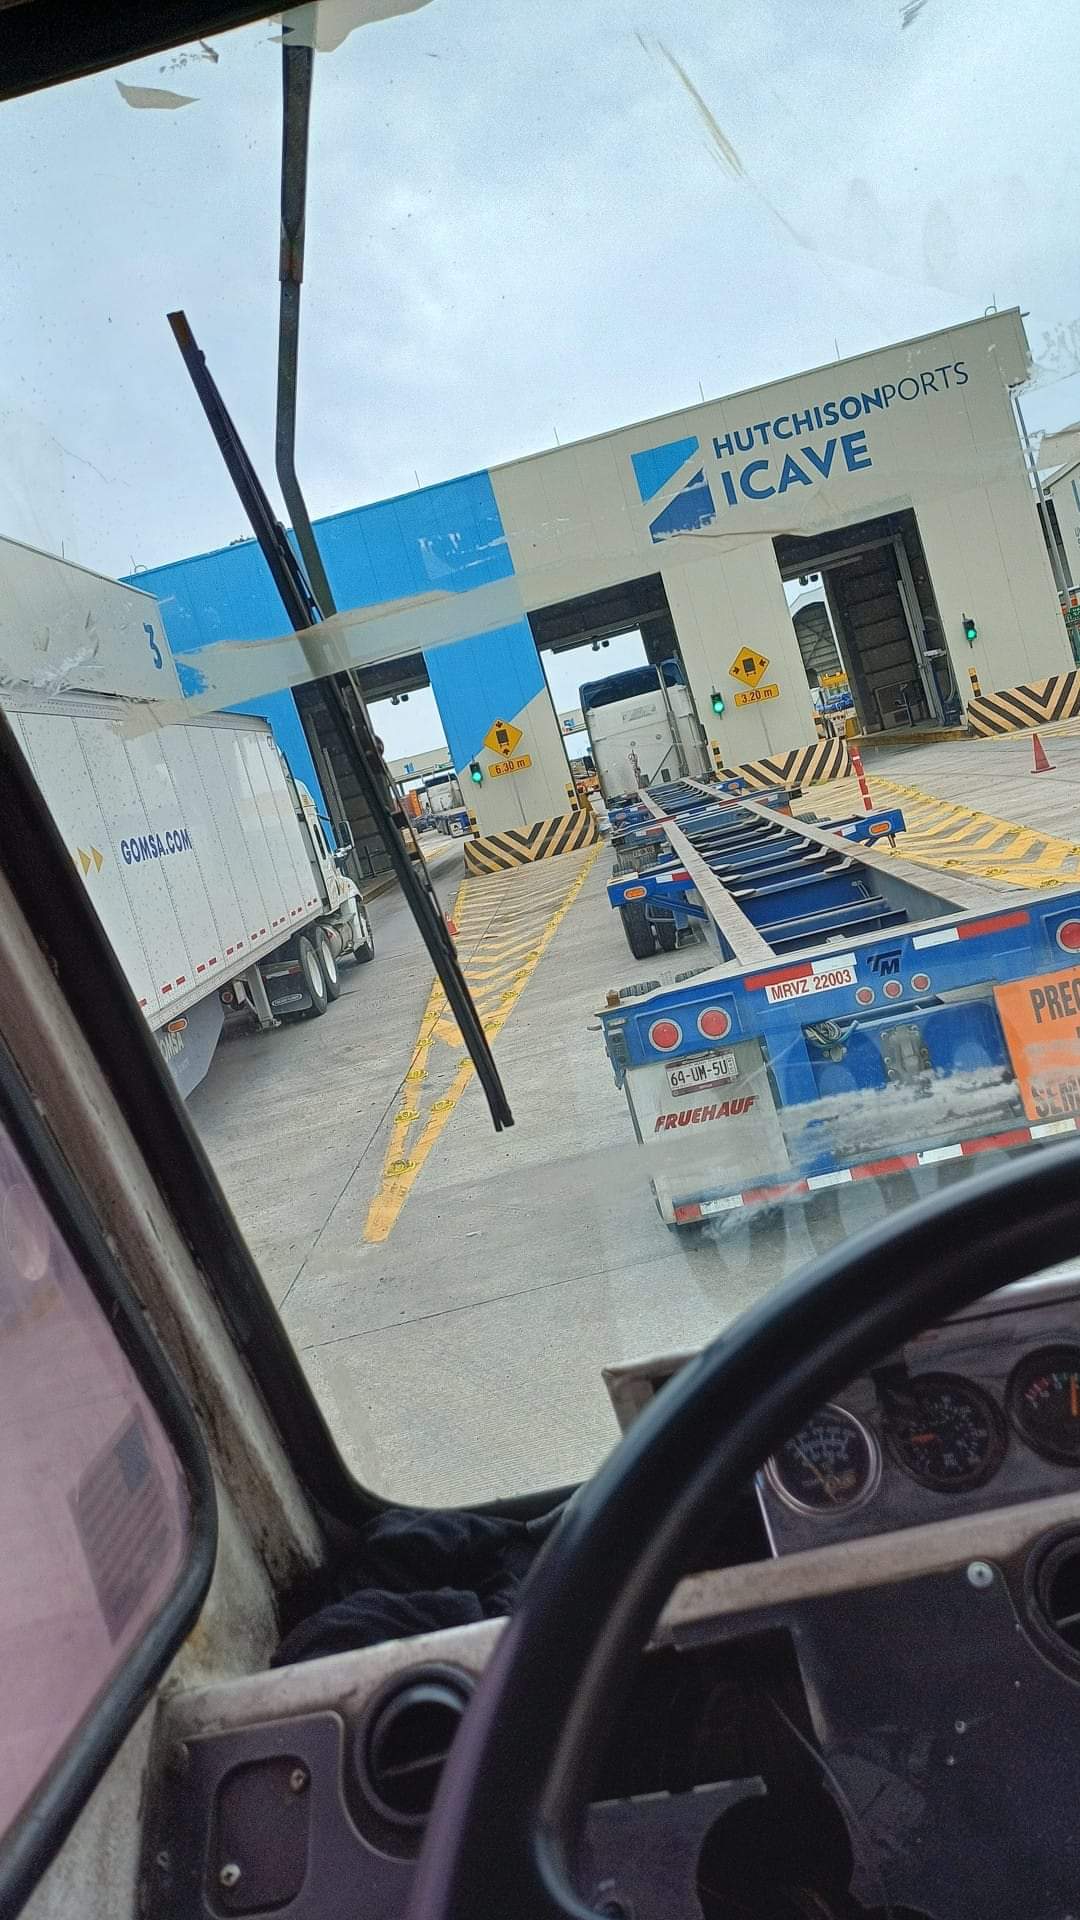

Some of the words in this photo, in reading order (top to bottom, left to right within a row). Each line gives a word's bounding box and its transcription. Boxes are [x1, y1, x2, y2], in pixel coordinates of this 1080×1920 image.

[719, 429, 873, 506] ICAVE
[143, 622, 163, 669] 3
[742, 690, 761, 703] 3.20
[764, 689, 773, 698] m
[495, 760, 514, 774] 6.30
[517, 759, 526, 768] m
[120, 828, 193, 865] GOMSA.COM
[770, 976, 810, 1001] MRVZ
[813, 968, 852, 990] 22003
[159, 1032, 185, 1063] OMSA
[654, 1094, 759, 1133] FRUEHAUF
